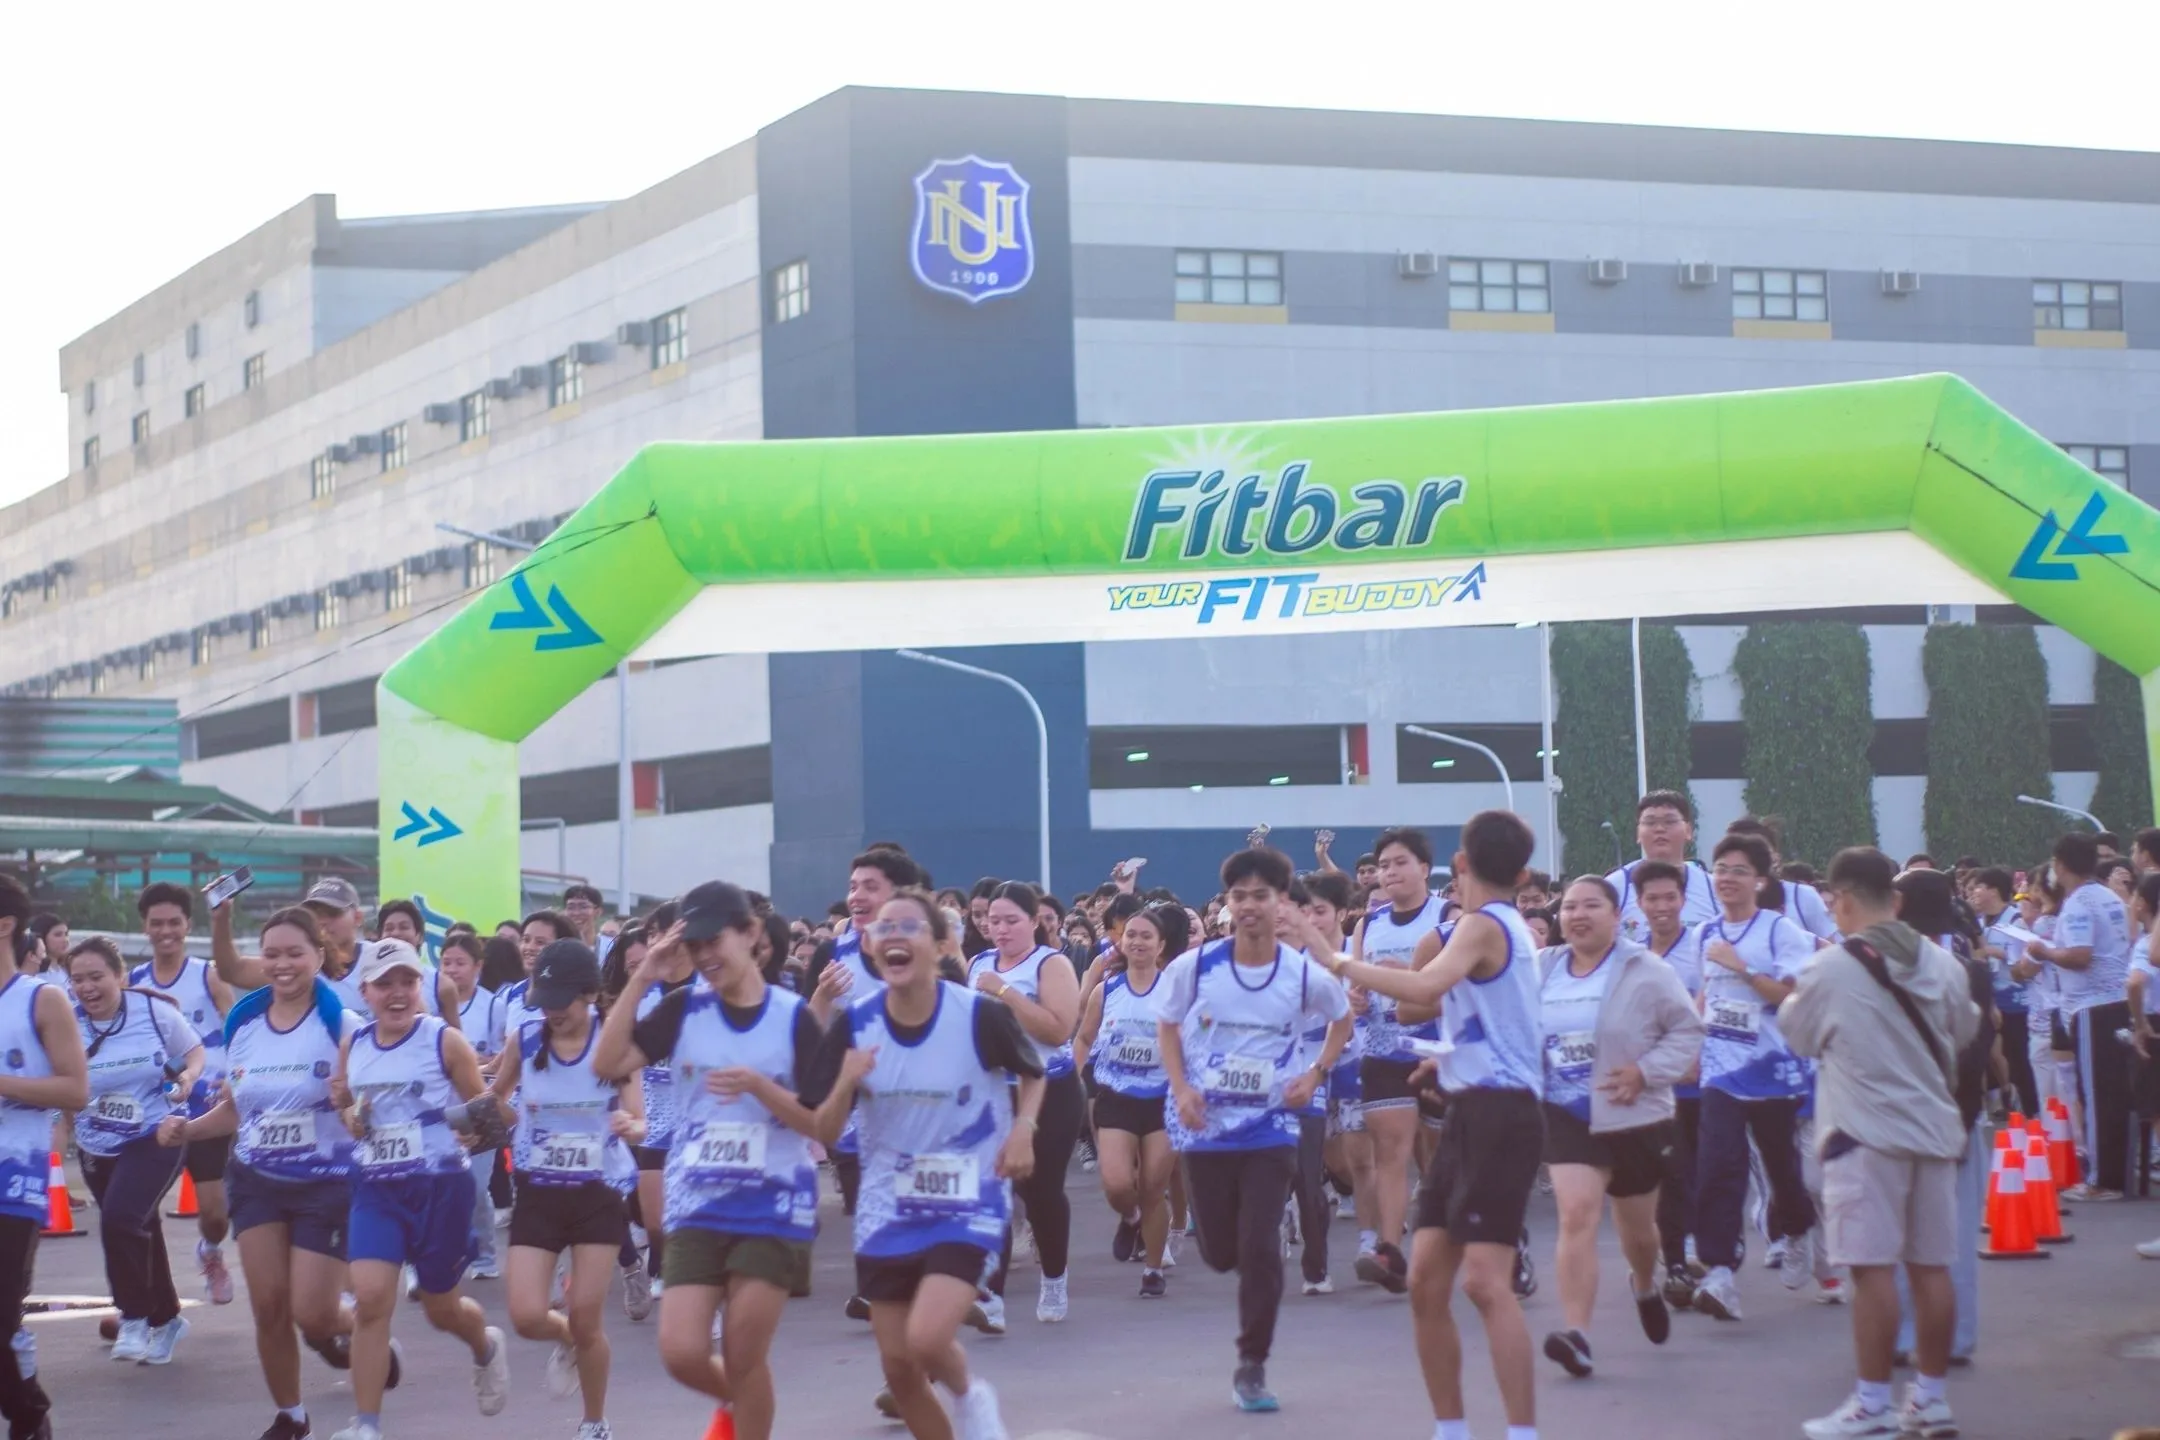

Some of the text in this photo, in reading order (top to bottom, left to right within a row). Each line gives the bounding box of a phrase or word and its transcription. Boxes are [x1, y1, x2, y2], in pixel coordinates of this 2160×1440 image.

[950, 270, 999, 285] 1900
[1123, 461, 1466, 561] Fitbar
[1108, 573, 1460, 624] YOUR FIT BUDDY
[1219, 1069, 1262, 1091] 3036
[259, 1123, 302, 1145] 3273
[543, 1146, 589, 1168] 3674
[702, 1140, 749, 1163] 4204
